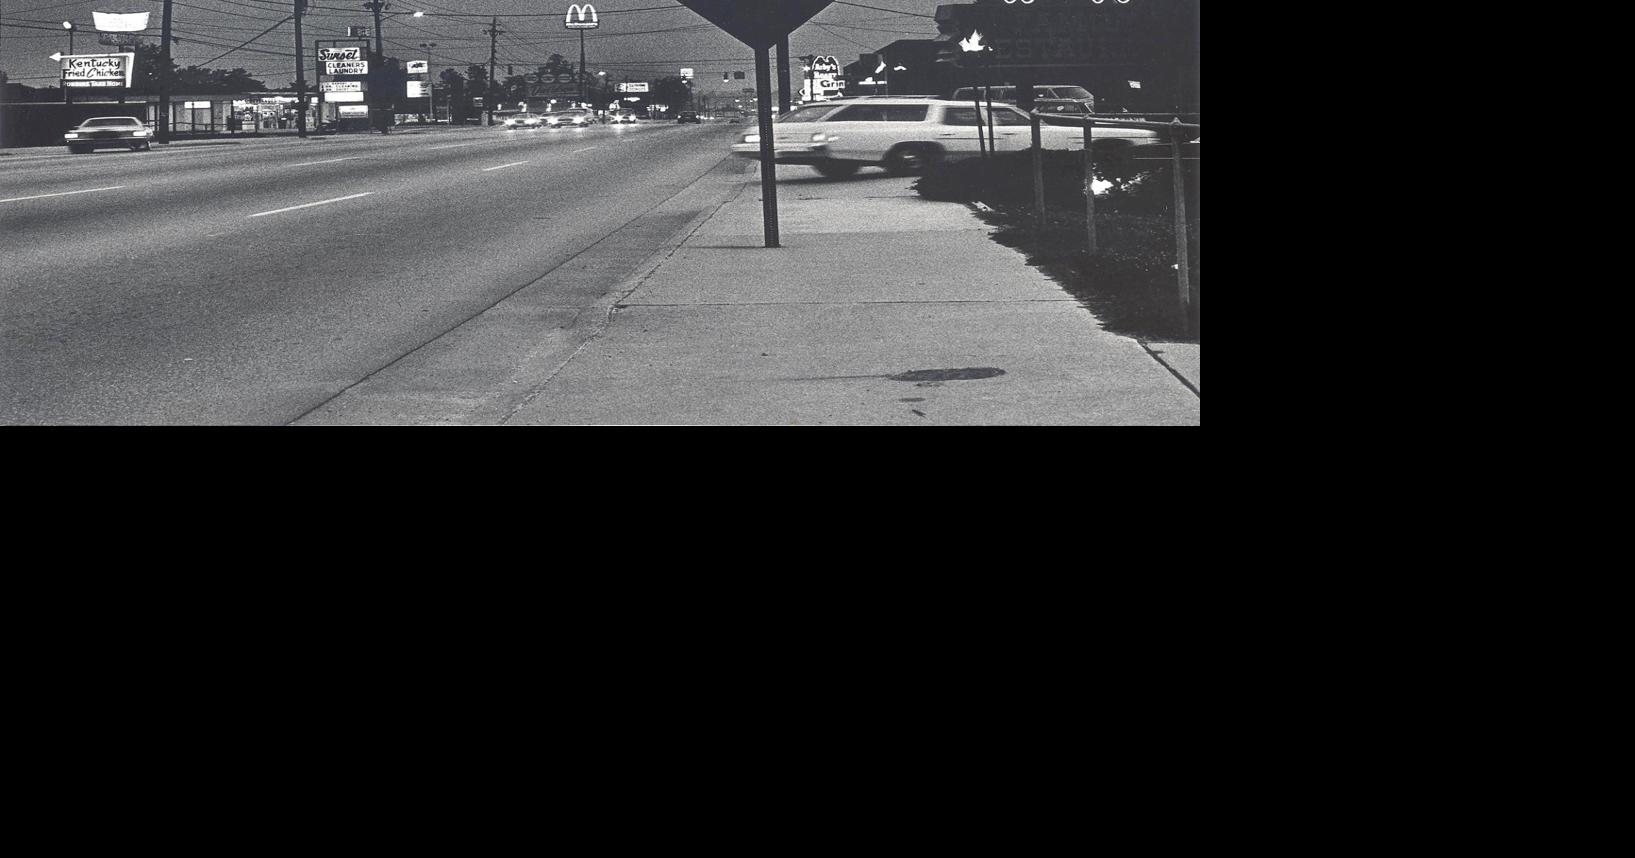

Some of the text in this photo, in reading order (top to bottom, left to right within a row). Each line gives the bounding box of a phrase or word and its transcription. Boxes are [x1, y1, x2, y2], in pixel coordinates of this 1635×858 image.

[319, 48, 358, 61] Sunset
[68, 58, 121, 69] Kentucky
[62, 68, 125, 79] Fried Chicken
